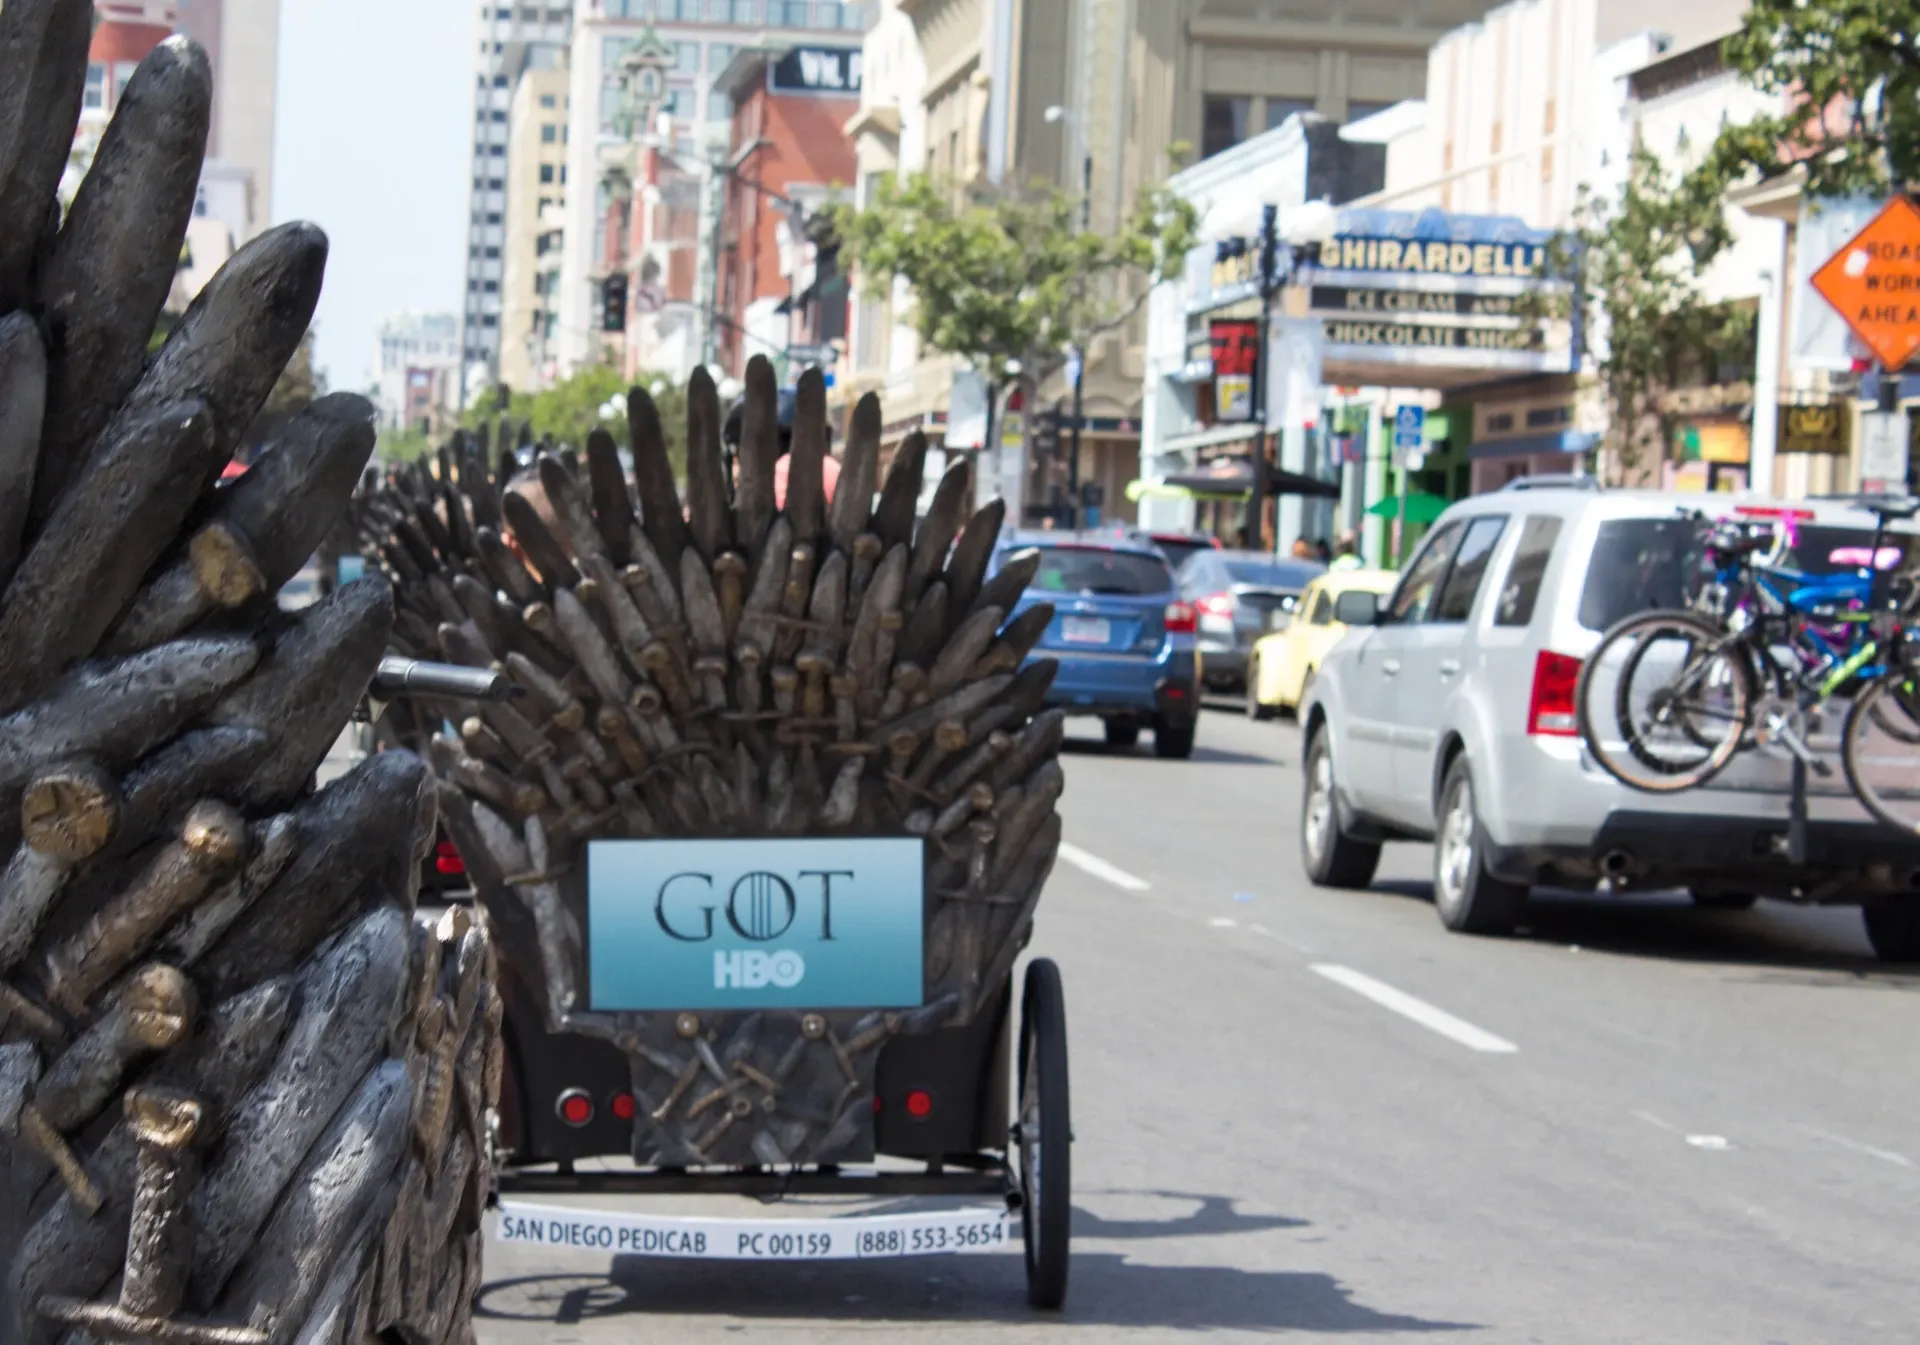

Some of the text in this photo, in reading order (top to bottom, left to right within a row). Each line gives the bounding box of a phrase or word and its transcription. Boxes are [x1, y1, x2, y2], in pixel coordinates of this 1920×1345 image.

[1319, 236, 1545, 276] GHIRARDELLI
[1384, 291, 1456, 315] CREAM
[1859, 303, 1920, 325] AHEA
[1323, 322, 1454, 347] CHOCOLATE
[654, 870, 854, 942] GOT
[713, 949, 806, 990] HBO
[503, 1216, 1003, 1258] SAN DIEGO PEDICAB PC 00159 (888) 553-5654
